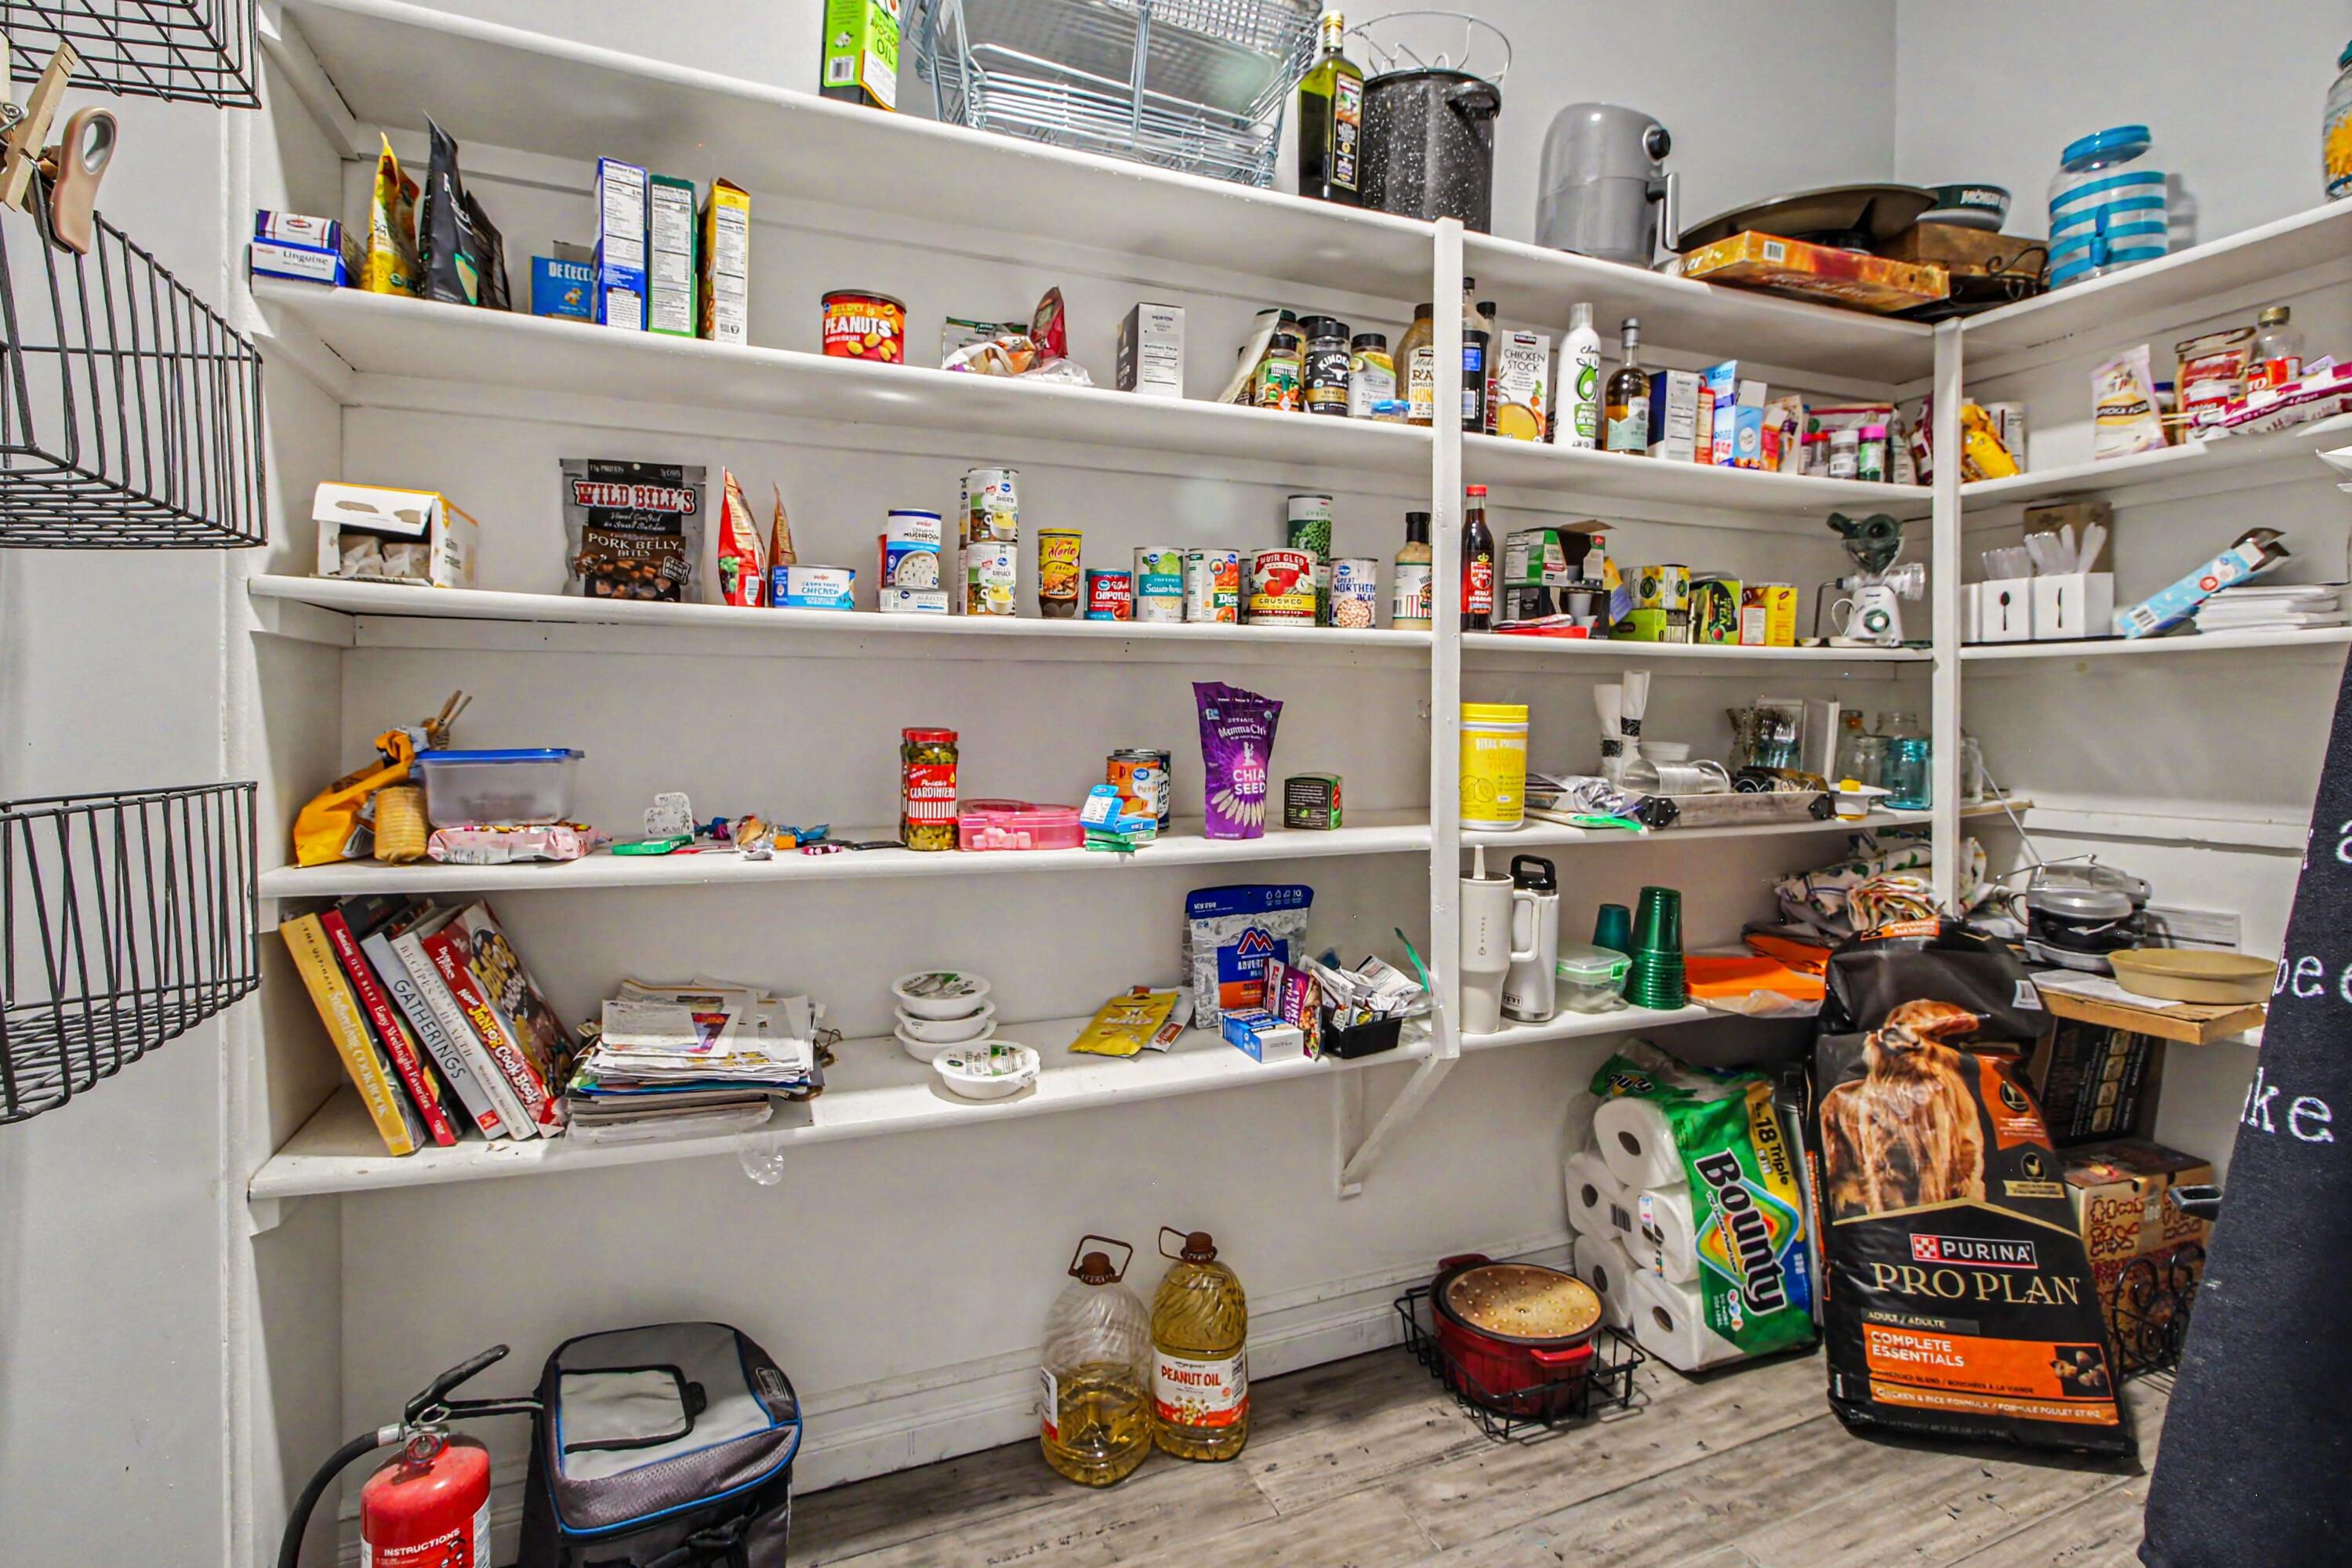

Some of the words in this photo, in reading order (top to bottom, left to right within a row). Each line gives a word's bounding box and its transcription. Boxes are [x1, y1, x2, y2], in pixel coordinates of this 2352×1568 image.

[877, 38, 893, 64] OIL
[283, 249, 329, 265] Linguine
[549, 261, 563, 278] DE
[826, 315, 892, 338] PEANUTS
[1504, 349, 1545, 362] CHICKEN
[1508, 359, 1539, 373] STOCK
[576, 483, 629, 506] WILD
[635, 486, 695, 513] BILL'S
[588, 532, 630, 550] PORK
[636, 540, 680, 550] BELLY
[1260, 554, 1280, 565] MUIR
[1232, 768, 1265, 783] CHIA
[1235, 783, 1266, 796] SEED
[394, 980, 466, 1080] GATHERINGS
[374, 1004, 390, 1027] Easy
[385, 1027, 414, 1070] Weeknight
[407, 1070, 430, 1109] Favorites
[352, 1049, 389, 1119] COOKBOOK
[514, 1073, 540, 1105] Book
[1755, 1117, 1777, 1143] 18
[1770, 1144, 1788, 1185] Triple
[1695, 1148, 1786, 1315] Bounty
[1944, 1241, 2031, 1262] PURINA
[1871, 1263, 1965, 1299] PRO
[1973, 1272, 2080, 1305] PLAN
[1867, 1312, 1897, 1323] ADULT
[1907, 1317, 1946, 1329] ADULTE
[1871, 1330, 1952, 1352] COMPLETE
[1872, 1345, 1965, 1367] ESSENTIALS
[1162, 1365, 1202, 1386] PEANUT
[1204, 1374, 1221, 1387] OIL
[1876, 1388, 1915, 1401] CHICKEN
[1925, 1395, 1945, 1405] RICE
[1947, 1396, 1989, 1410] FORMULA
[1998, 1403, 2038, 1414] FORMULE
[2040, 1406, 2072, 1417] POULET
[384, 1528, 460, 1556] INSTRUCTIONS
